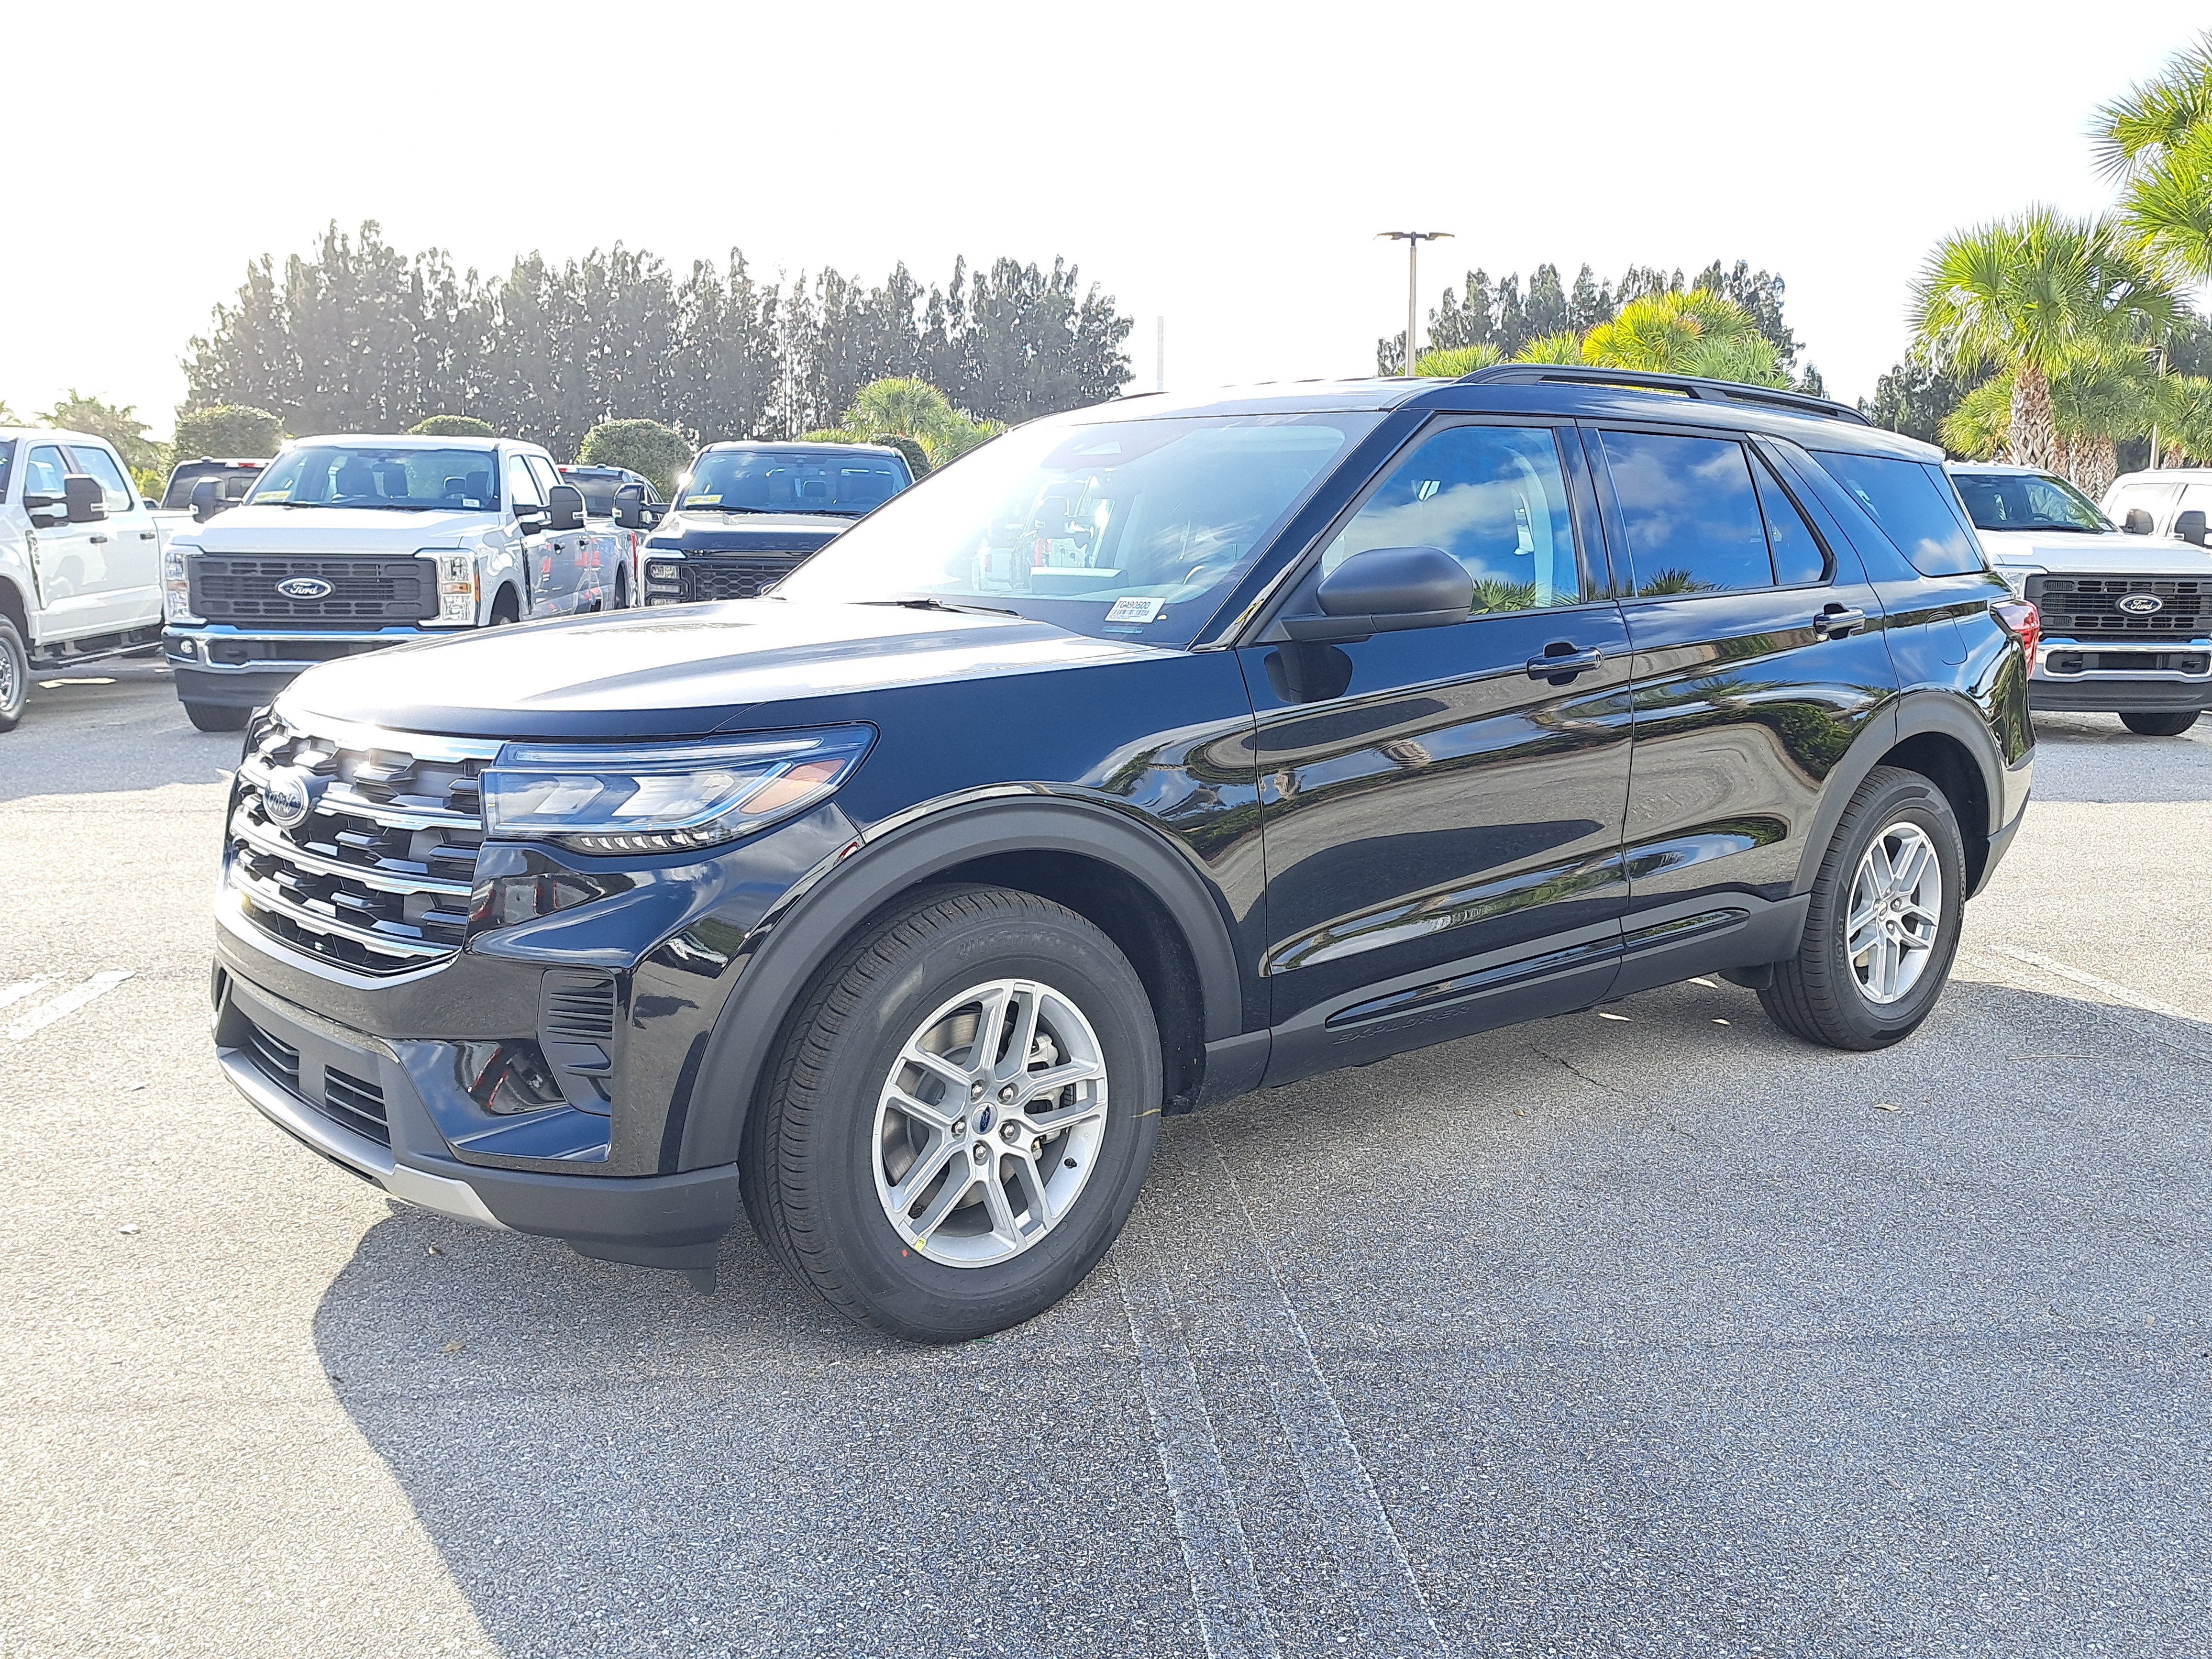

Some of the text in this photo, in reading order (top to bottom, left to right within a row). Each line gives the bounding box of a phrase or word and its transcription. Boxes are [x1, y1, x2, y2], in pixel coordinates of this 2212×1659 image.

[290, 583, 318, 594] Ford
[2130, 599, 2153, 610] Ford
[1333, 1005, 1470, 1045] EXPLORER
[981, 1110, 989, 1128] Ford
